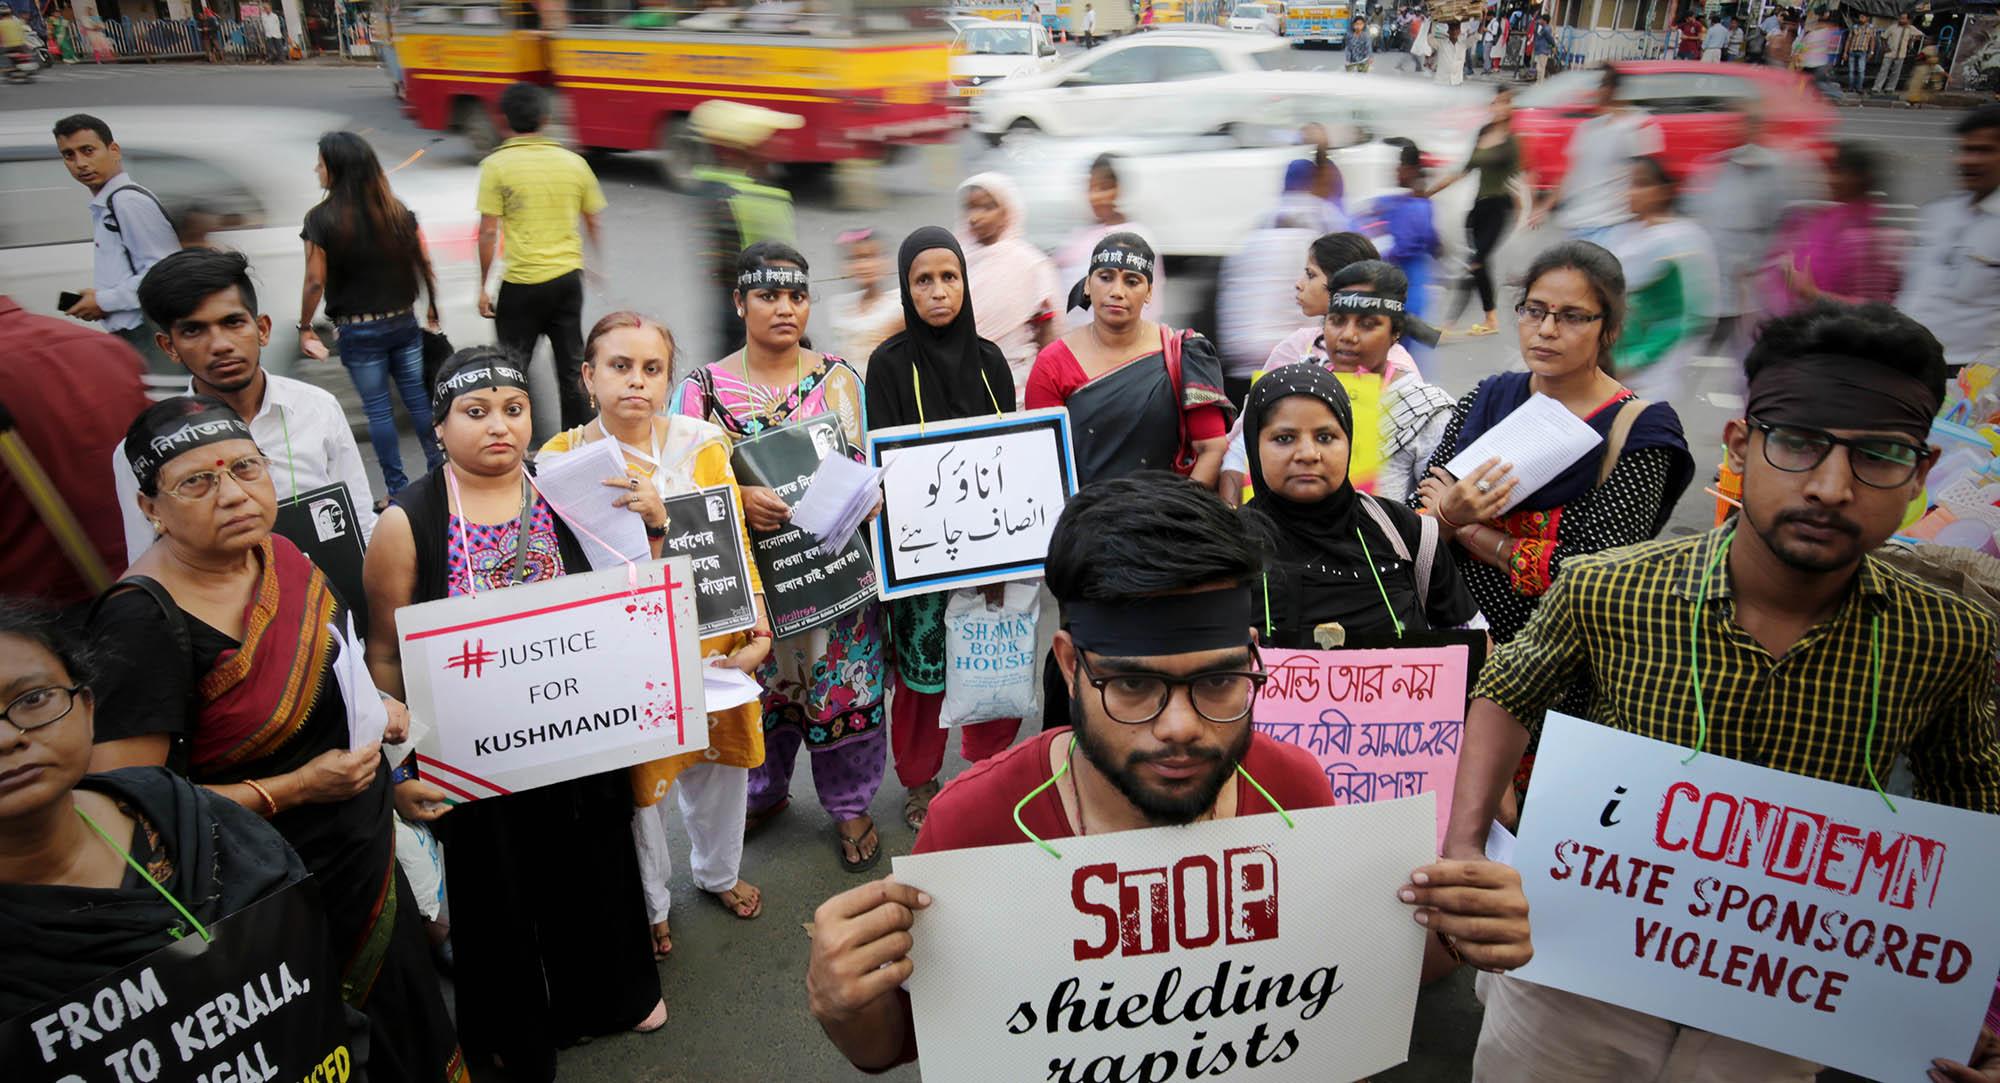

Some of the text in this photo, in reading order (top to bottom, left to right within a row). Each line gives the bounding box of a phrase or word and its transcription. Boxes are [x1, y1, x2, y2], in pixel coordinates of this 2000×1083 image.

[1333, 292, 1382, 309] নির্যাতন
[437, 367, 492, 399] নির্যাতন
[150, 420, 234, 457] নির্যাতন
[924, 445, 956, 509] کو
[668, 530, 715, 551] ধর্ষণের
[968, 497, 1046, 542] انصاف
[773, 546, 821, 572] দেওয়া হল
[775, 576, 804, 594] জবাব
[824, 555, 848, 575] জবাব
[846, 549, 861, 564] দাও
[698, 576, 737, 595] দাঁড়ান
[962, 619, 1028, 641] SHAMA
[970, 640, 1020, 657] BOOK
[956, 651, 1034, 671] HOUSE
[1327, 664, 1393, 703] আর
[1392, 663, 1444, 701] নয়
[529, 677, 579, 704] FOR
[474, 704, 637, 756] KUSHMANDI
[1599, 781, 1947, 910] i CONDEMN
[1070, 843, 1280, 962] STOP
[1550, 838, 1974, 985] STATE SPONSORED
[1634, 916, 1849, 1014] VIOLENCE
[30, 966, 168, 1064] FROM
[1006, 960, 1344, 1036] shielding
[104, 960, 311, 1083] TO KERALA,
[1047, 1022, 1302, 1083] rapists
